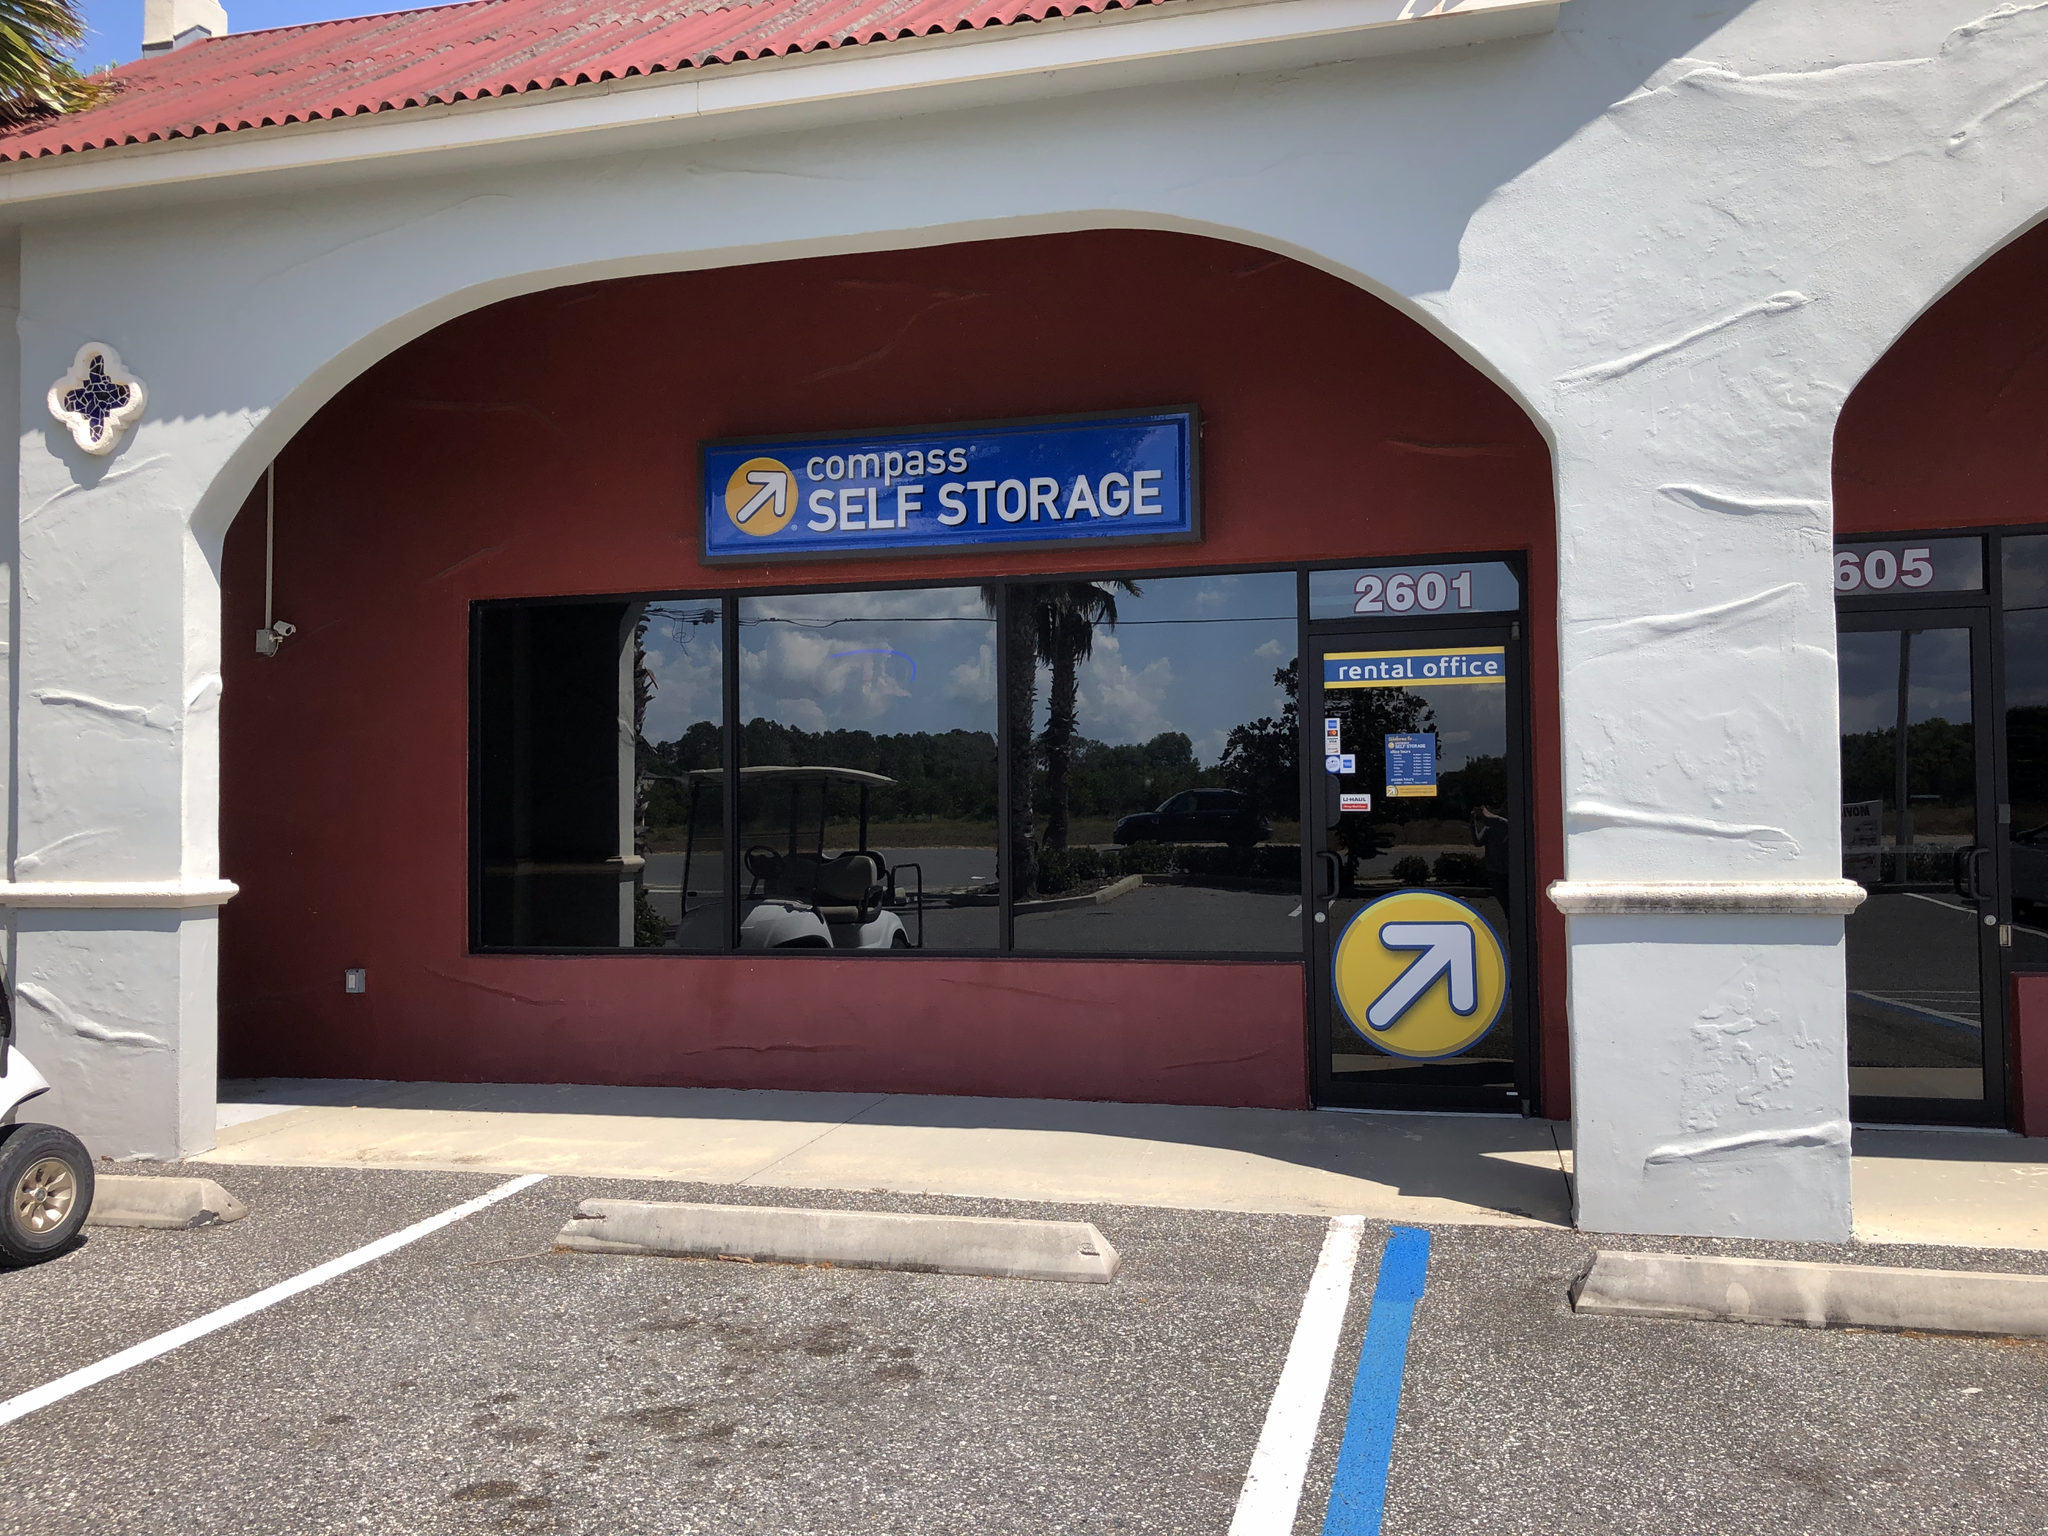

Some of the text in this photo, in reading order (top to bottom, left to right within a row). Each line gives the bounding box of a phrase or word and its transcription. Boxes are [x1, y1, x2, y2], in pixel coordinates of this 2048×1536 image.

[806, 447, 969, 486] compass
[806, 469, 1163, 532] SELF STORAGE
[1354, 570, 1472, 614] 2601
[1339, 657, 1498, 680] rental office
